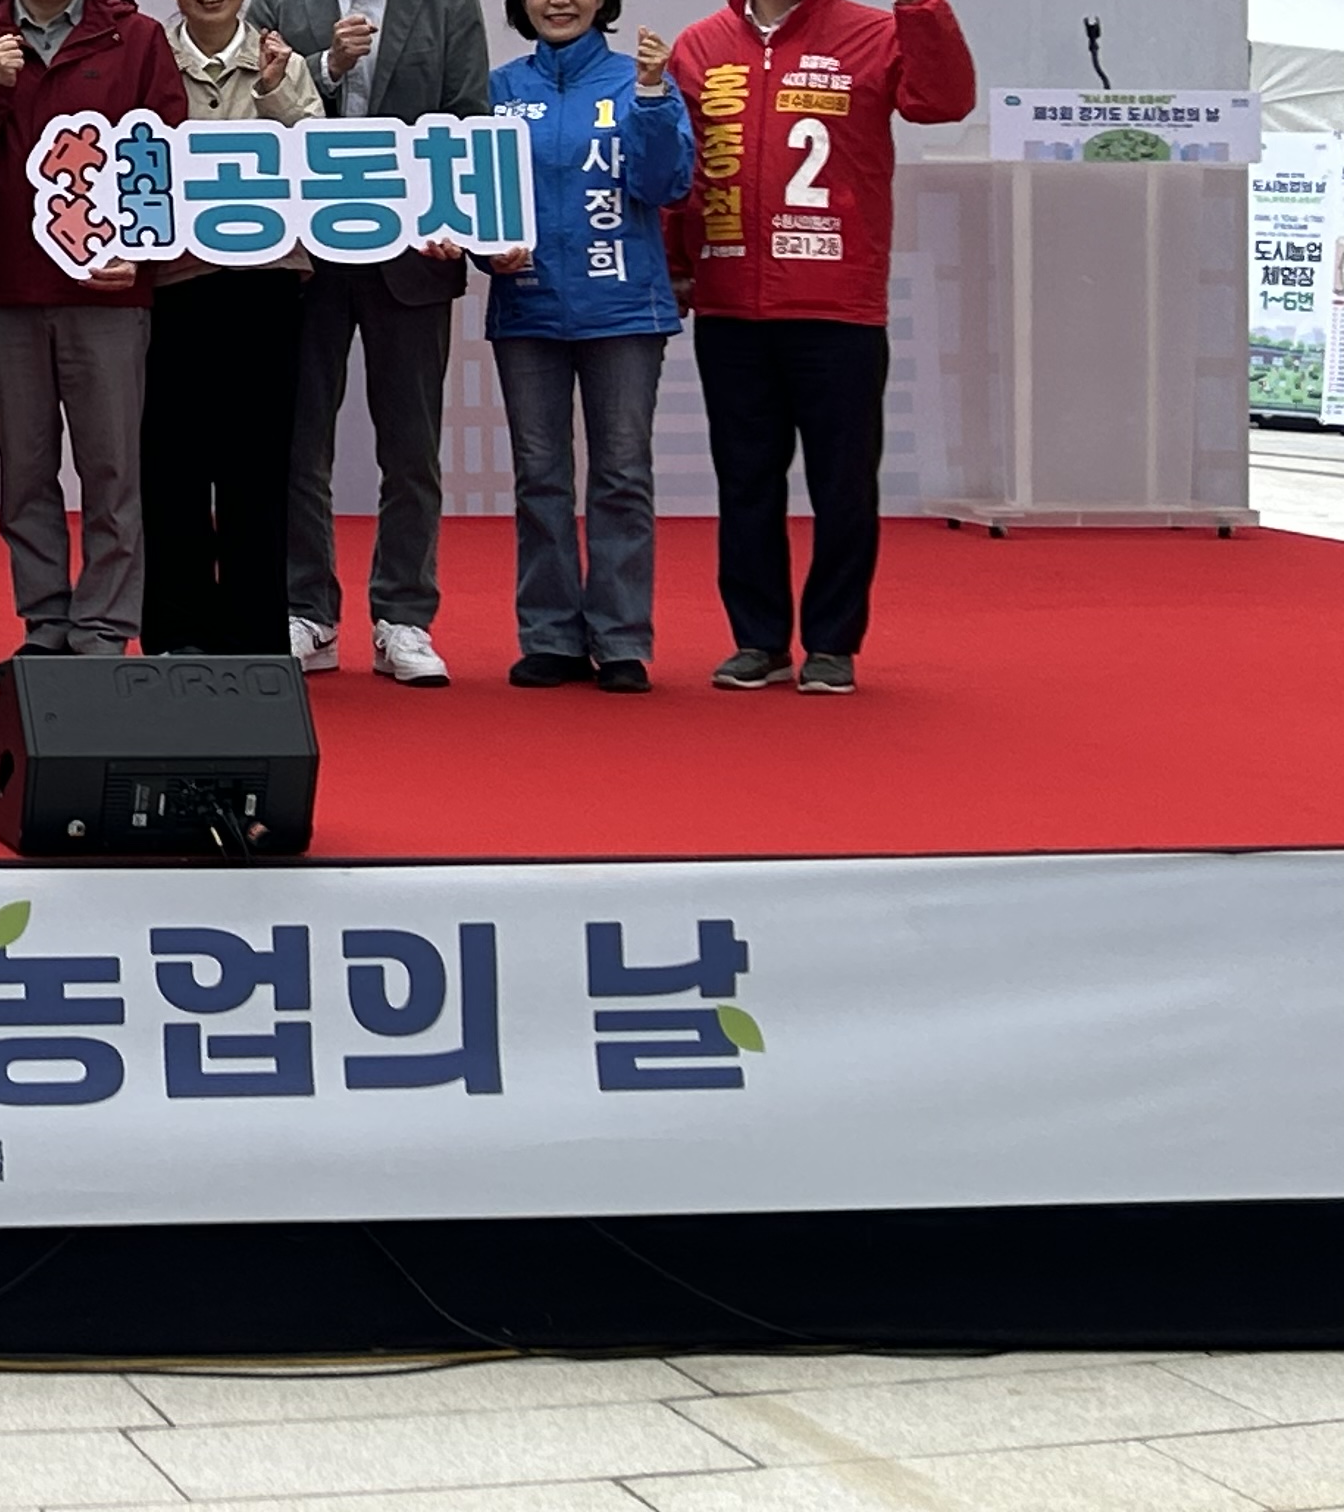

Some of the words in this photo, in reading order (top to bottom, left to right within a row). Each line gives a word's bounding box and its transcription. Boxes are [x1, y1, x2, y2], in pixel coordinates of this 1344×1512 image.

[593, 99, 617, 129] 1
[700, 64, 750, 241] 홍종철
[785, 117, 830, 208] 2
[183, 126, 525, 252] 공동체
[582, 136, 627, 282] 사정희
[1254, 240, 1323, 262] 도시농업
[1261, 265, 1315, 287] 체험장
[585, 919, 756, 1092] 날
